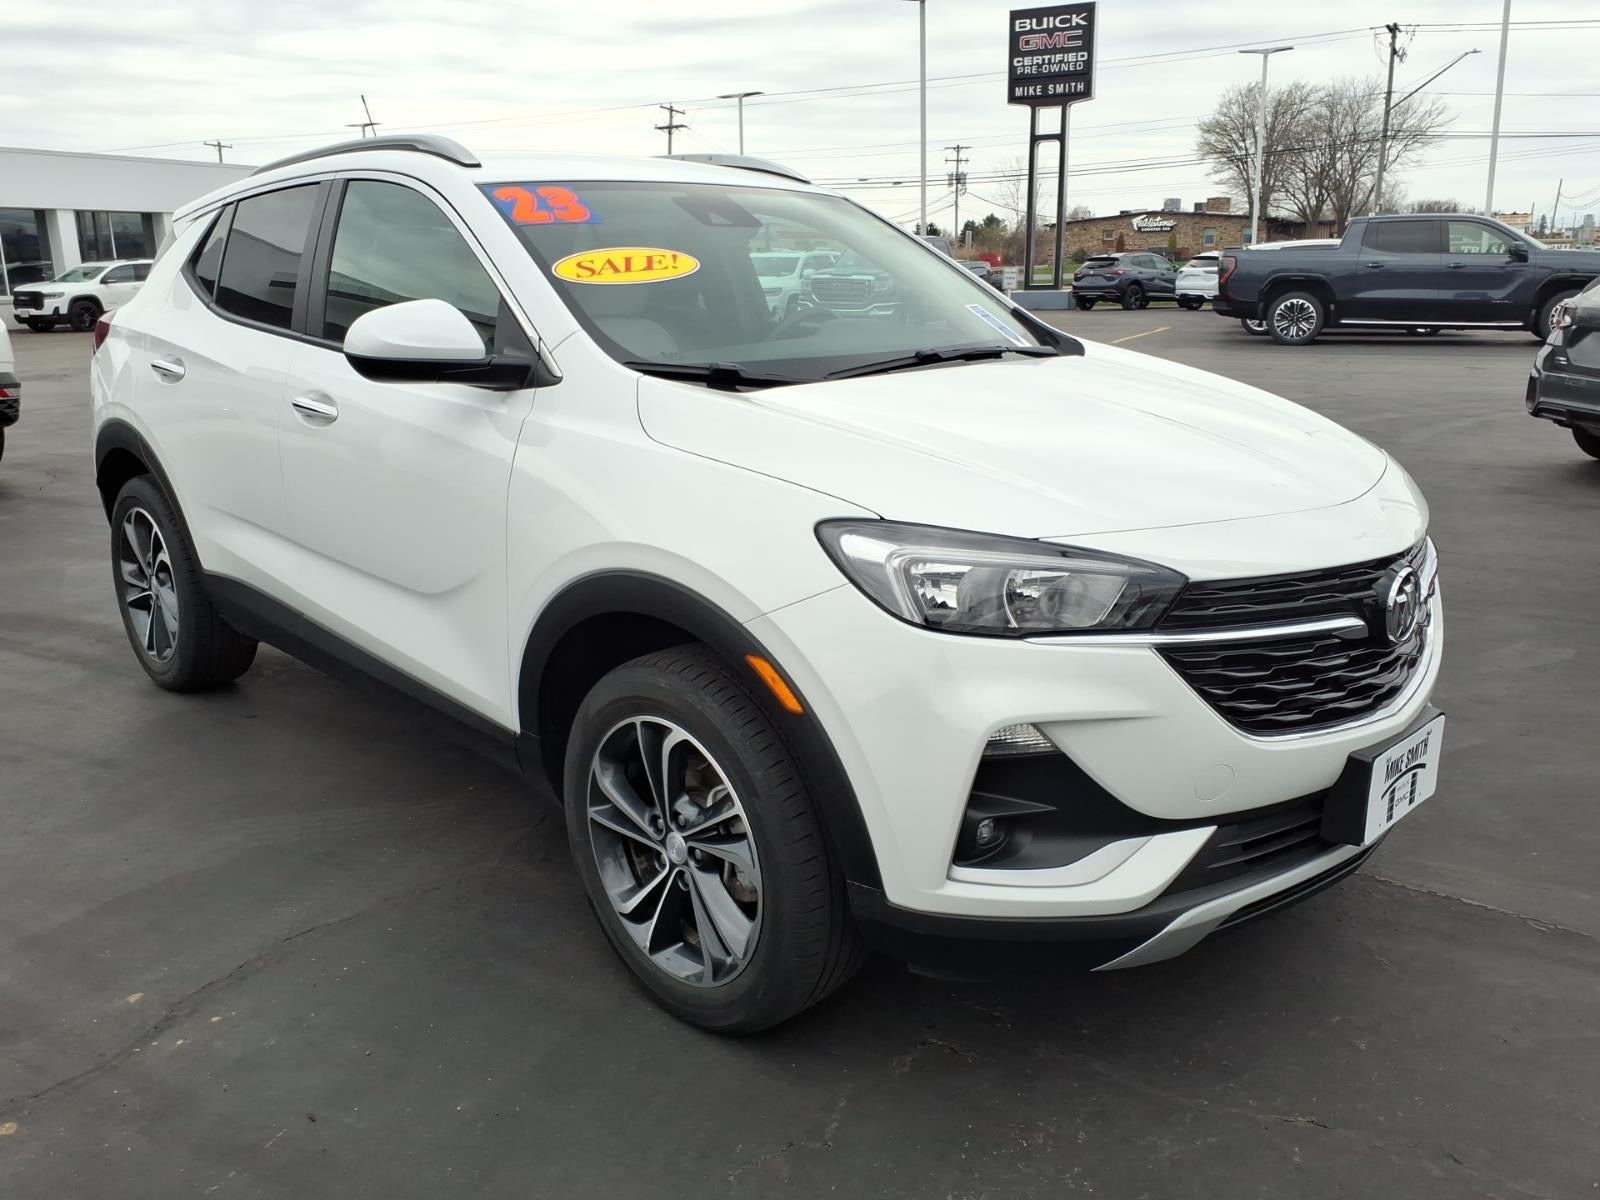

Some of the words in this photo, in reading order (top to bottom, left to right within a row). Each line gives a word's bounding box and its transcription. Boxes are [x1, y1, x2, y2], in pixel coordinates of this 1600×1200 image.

[1015, 13, 1088, 31] BUICK
[1020, 30, 1083, 51] GMC
[1013, 52, 1088, 66] CERTIFIED
[1017, 61, 1084, 75] PRE-OWNED
[1015, 85, 1042, 97] MIKE
[1048, 82, 1084, 94] SMITH
[493, 185, 591, 224] 23
[576, 254, 678, 278] SALE!
[1385, 753, 1405, 783] MIKE
[1405, 736, 1430, 769] SMITH
